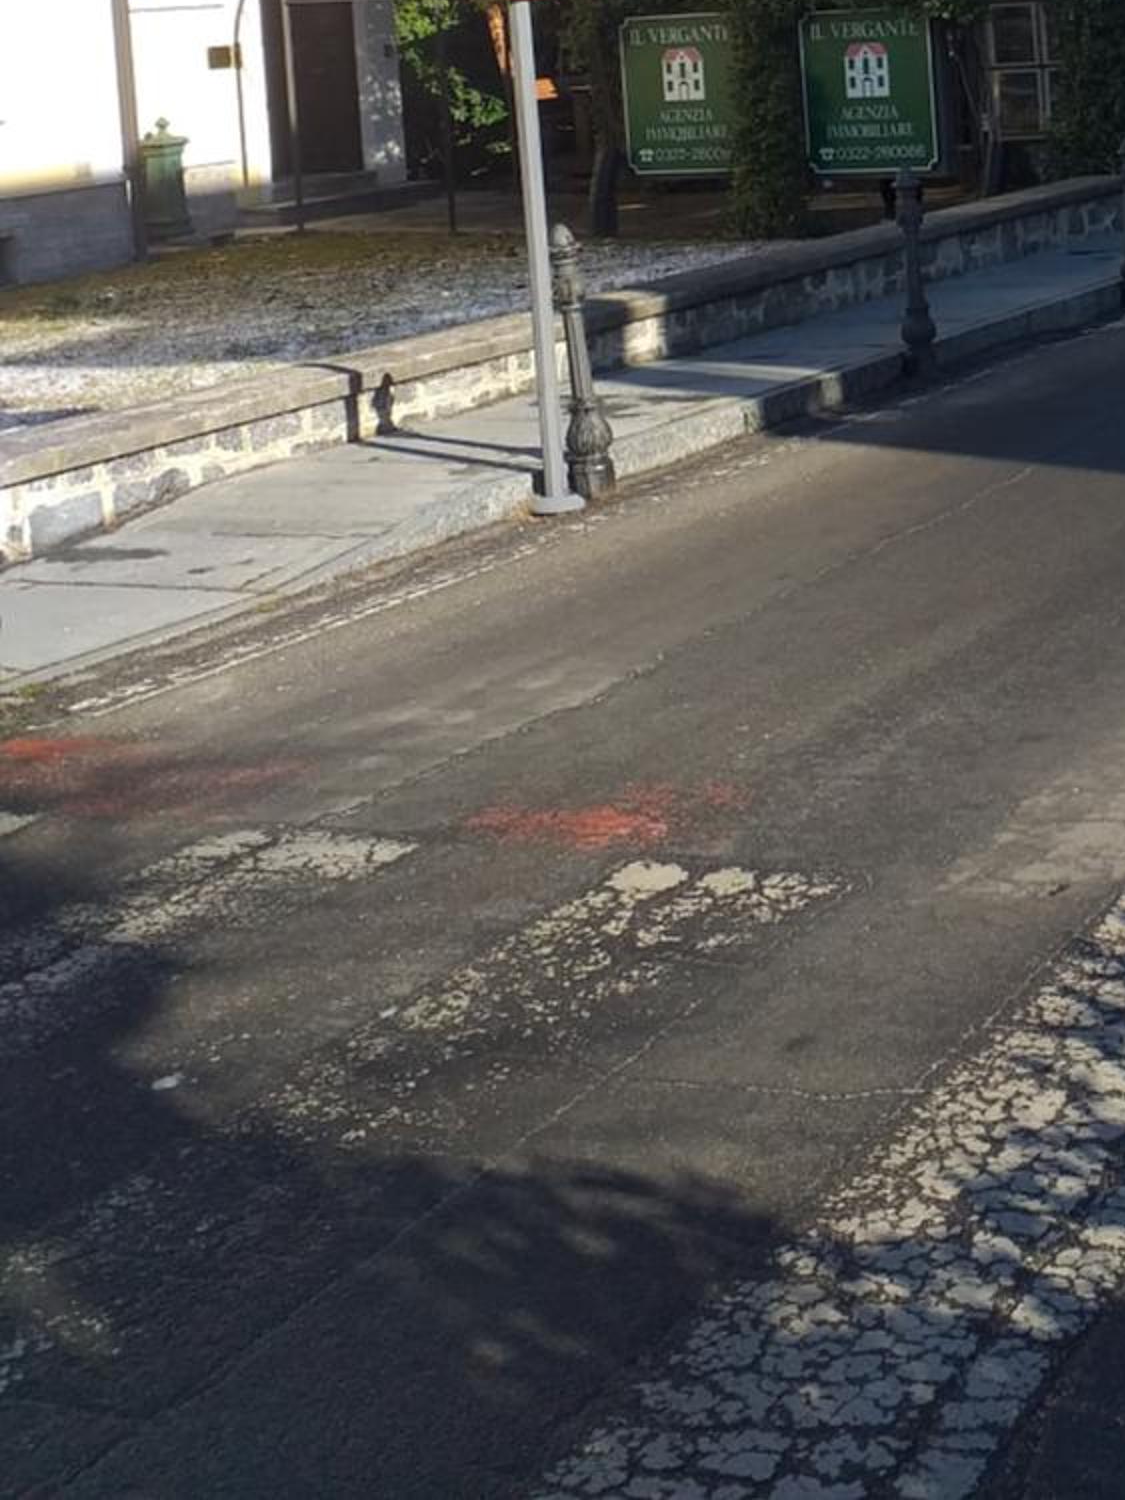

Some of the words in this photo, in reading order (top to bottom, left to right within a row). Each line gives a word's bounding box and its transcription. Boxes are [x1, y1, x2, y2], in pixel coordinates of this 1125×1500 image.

[830, 19, 920, 38] VERGANTE
[660, 109, 712, 122] AGENZIA
[841, 106, 898, 120] AGENZIA
[826, 121, 914, 140] IMMOBILIARE
